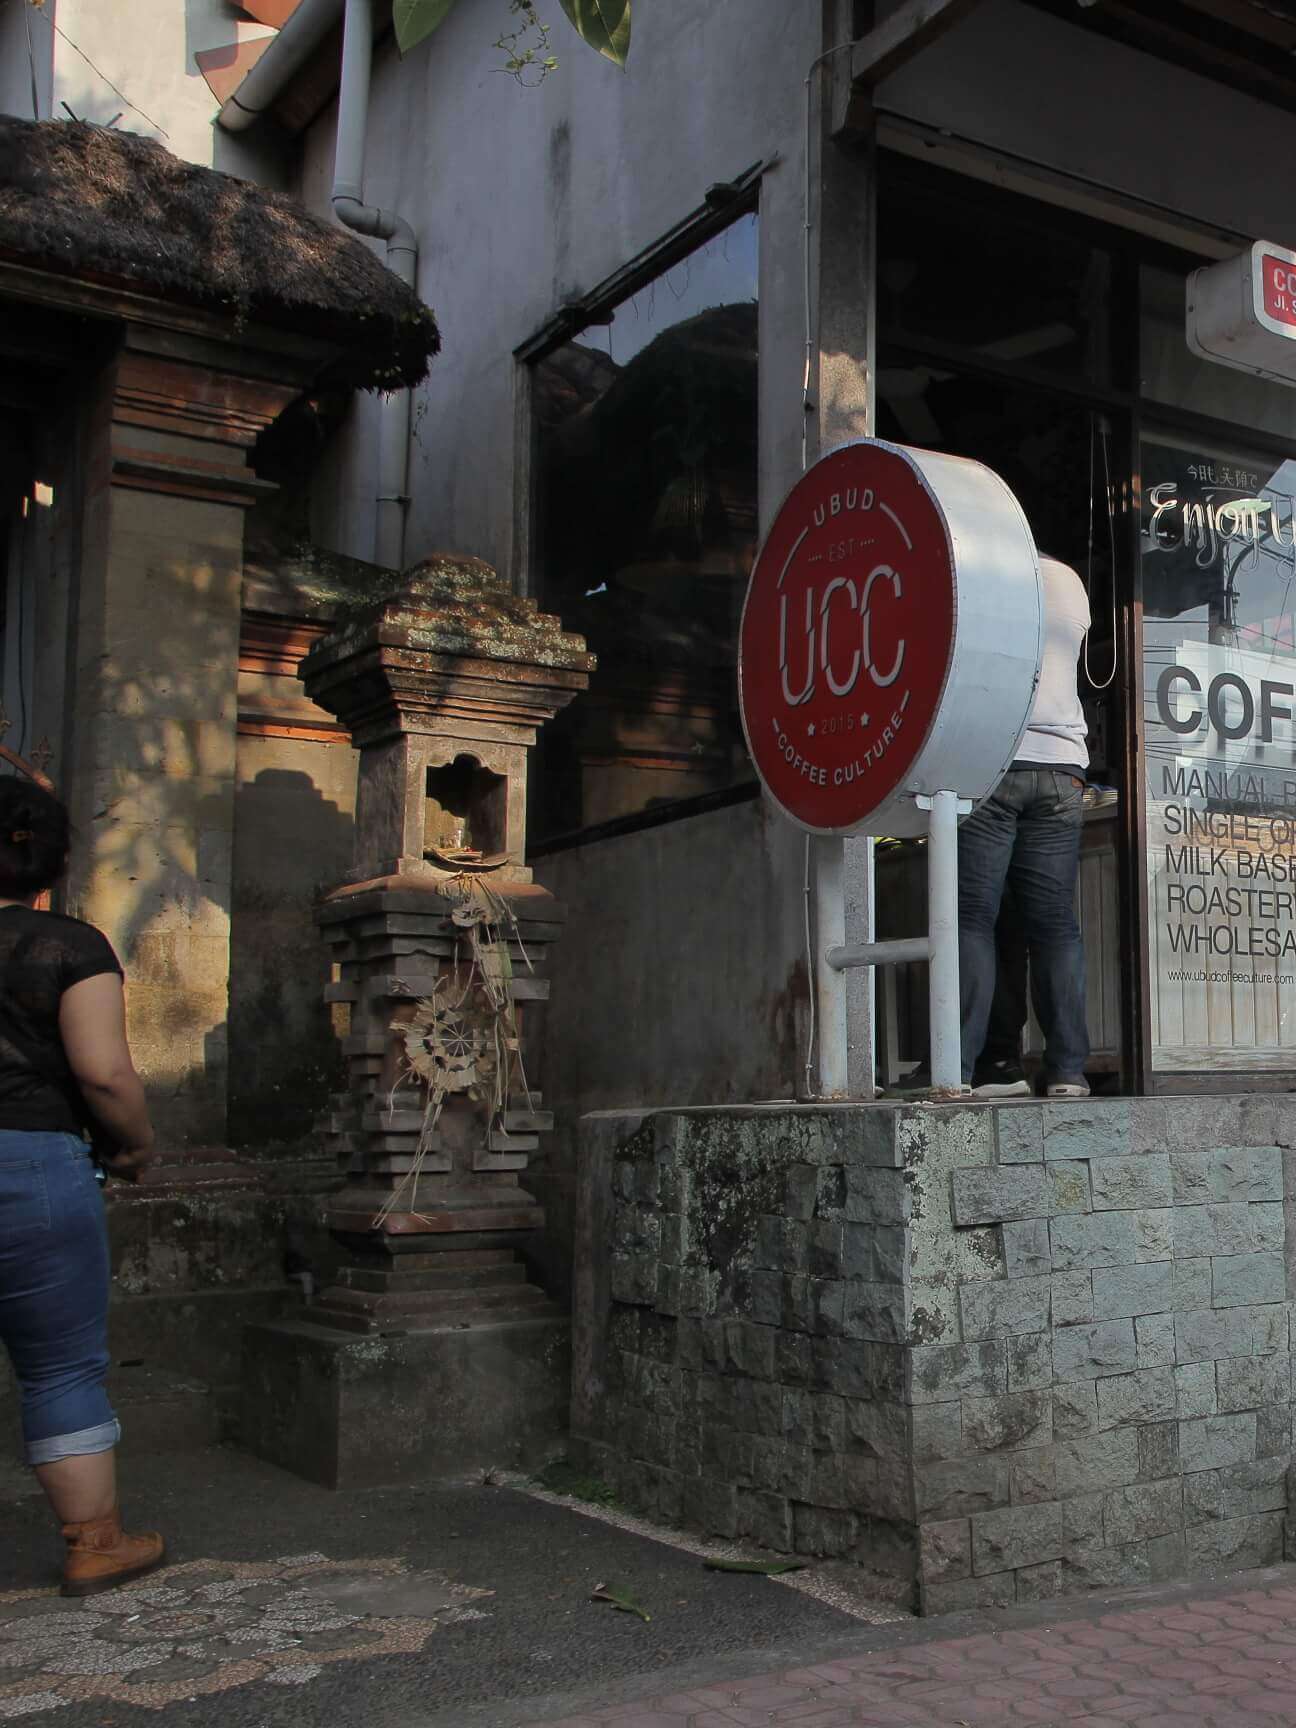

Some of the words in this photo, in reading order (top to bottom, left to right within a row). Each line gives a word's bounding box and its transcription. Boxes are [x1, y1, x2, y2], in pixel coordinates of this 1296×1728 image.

[814, 487, 874, 526] UBUD
[1147, 482, 1261, 573] Enjoy
[779, 564, 905, 706] UCC
[778, 734, 827, 785] COFFEE
[834, 712, 903, 785] CULTURE
[1163, 766, 1265, 799] MANUAL
[1163, 805, 1260, 843] SINGLE
[1165, 843, 1229, 877] MILK
[1167, 969, 1294, 985] www.ubudcoffeeculture.com
